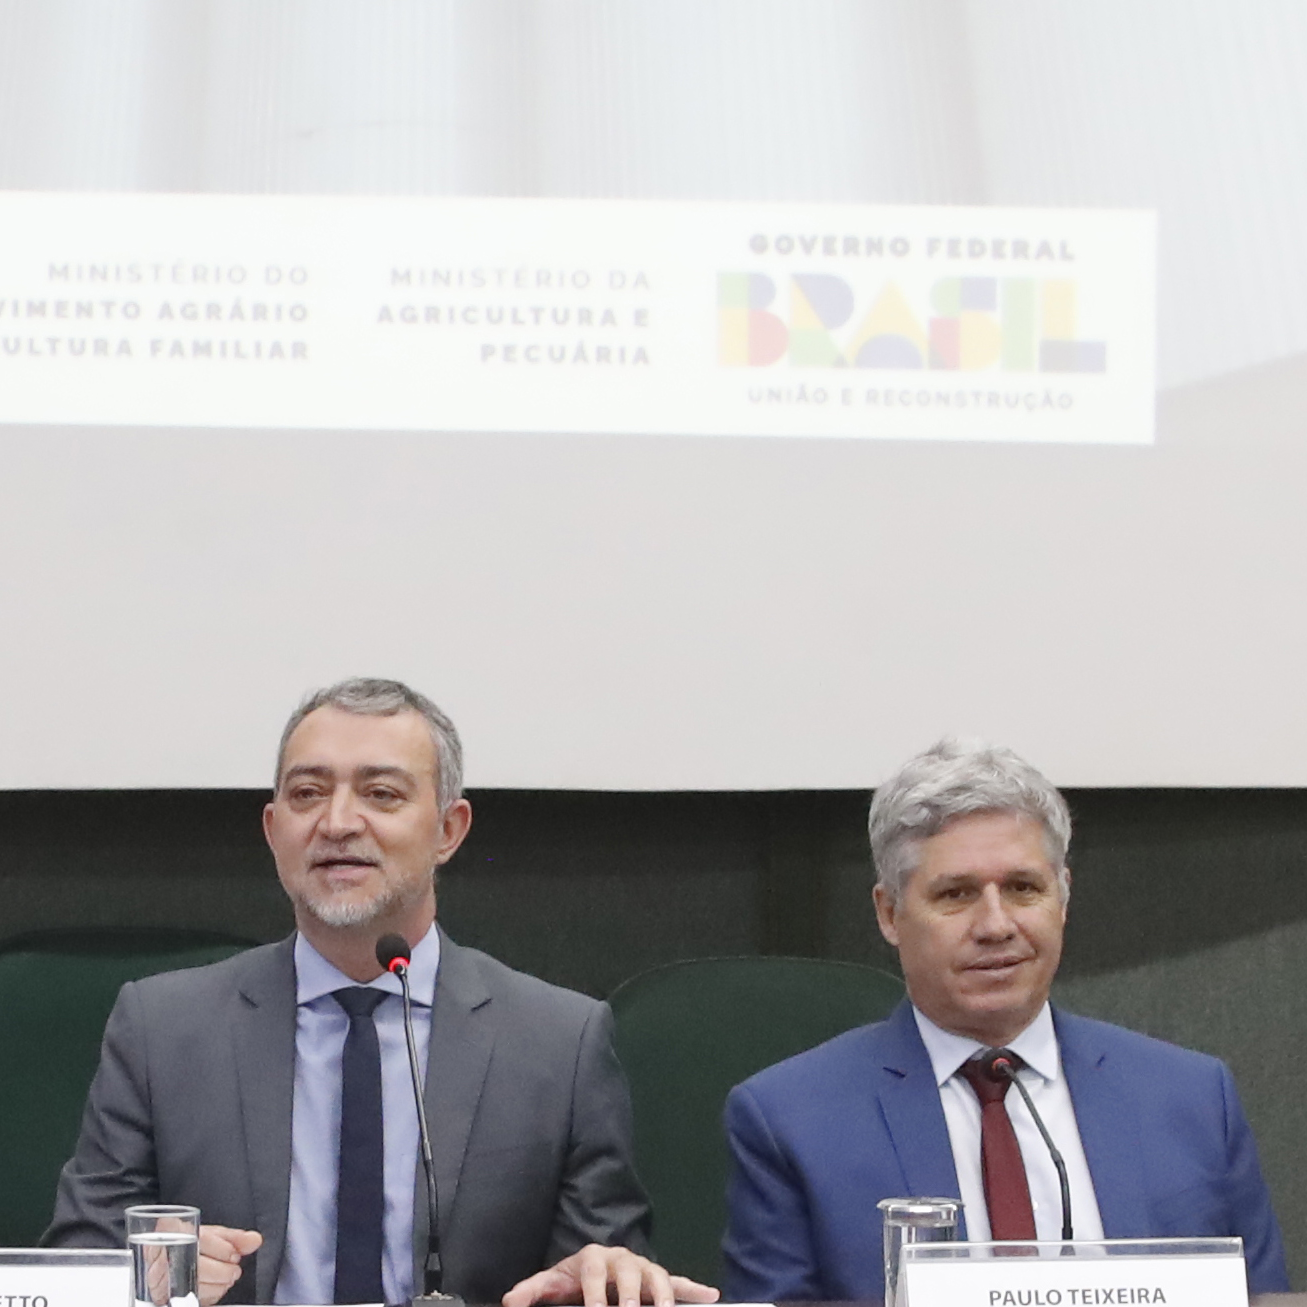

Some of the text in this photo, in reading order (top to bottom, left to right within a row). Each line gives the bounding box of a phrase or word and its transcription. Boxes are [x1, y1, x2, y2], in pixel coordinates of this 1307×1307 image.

[747, 232, 1076, 263] GOVERNO FEDERAL
[47, 257, 311, 287] MINISTÉRIO DO
[389, 262, 653, 291] MINISTÉRIO DA
[157, 294, 311, 324] AGRÁRIO
[375, 303, 653, 329] AGRICULTURA E
[716, 271, 1107, 374] BRASIL
[148, 338, 310, 362] FAMILIAR
[478, 336, 653, 368] PECUÁRIA
[747, 382, 1076, 414] UNIÃO E RECONSTRUÇÃO
[988, 1286, 1167, 1307] PAULO TEIXEIRA
